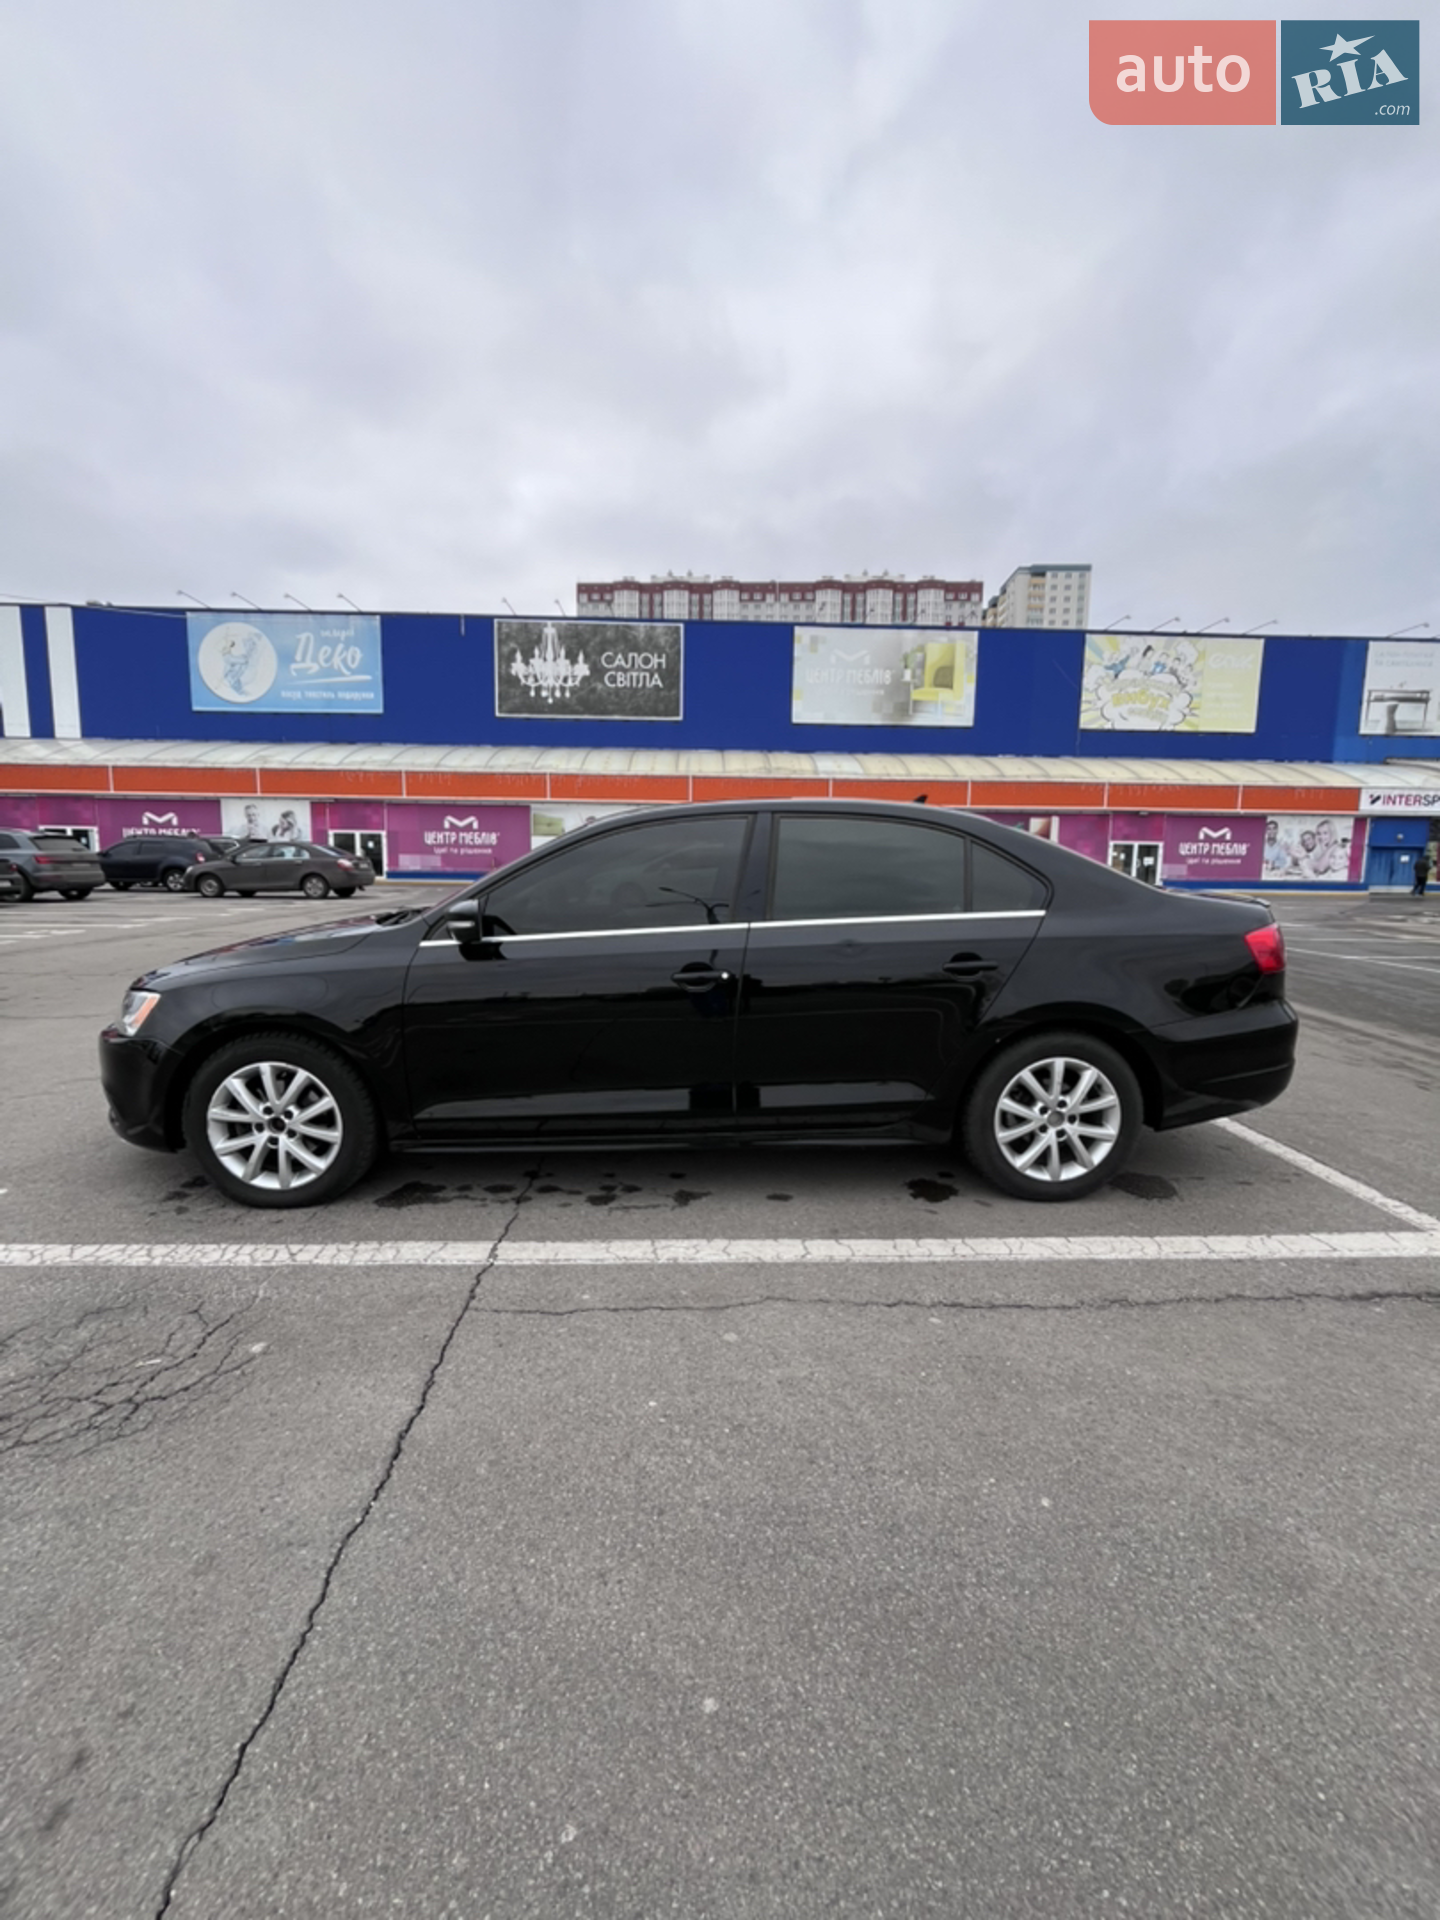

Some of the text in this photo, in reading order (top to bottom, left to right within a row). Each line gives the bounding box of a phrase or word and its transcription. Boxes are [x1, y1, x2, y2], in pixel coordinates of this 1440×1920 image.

[289, 632, 363, 676] Деко
[601, 651, 666, 669] САЛОН
[604, 671, 664, 688] СВІТЛА
[424, 831, 498, 845] ЦЕНТР МЕБЛІВ
[1179, 842, 1248, 856] ЦЕНТР МЕБЛІВ
